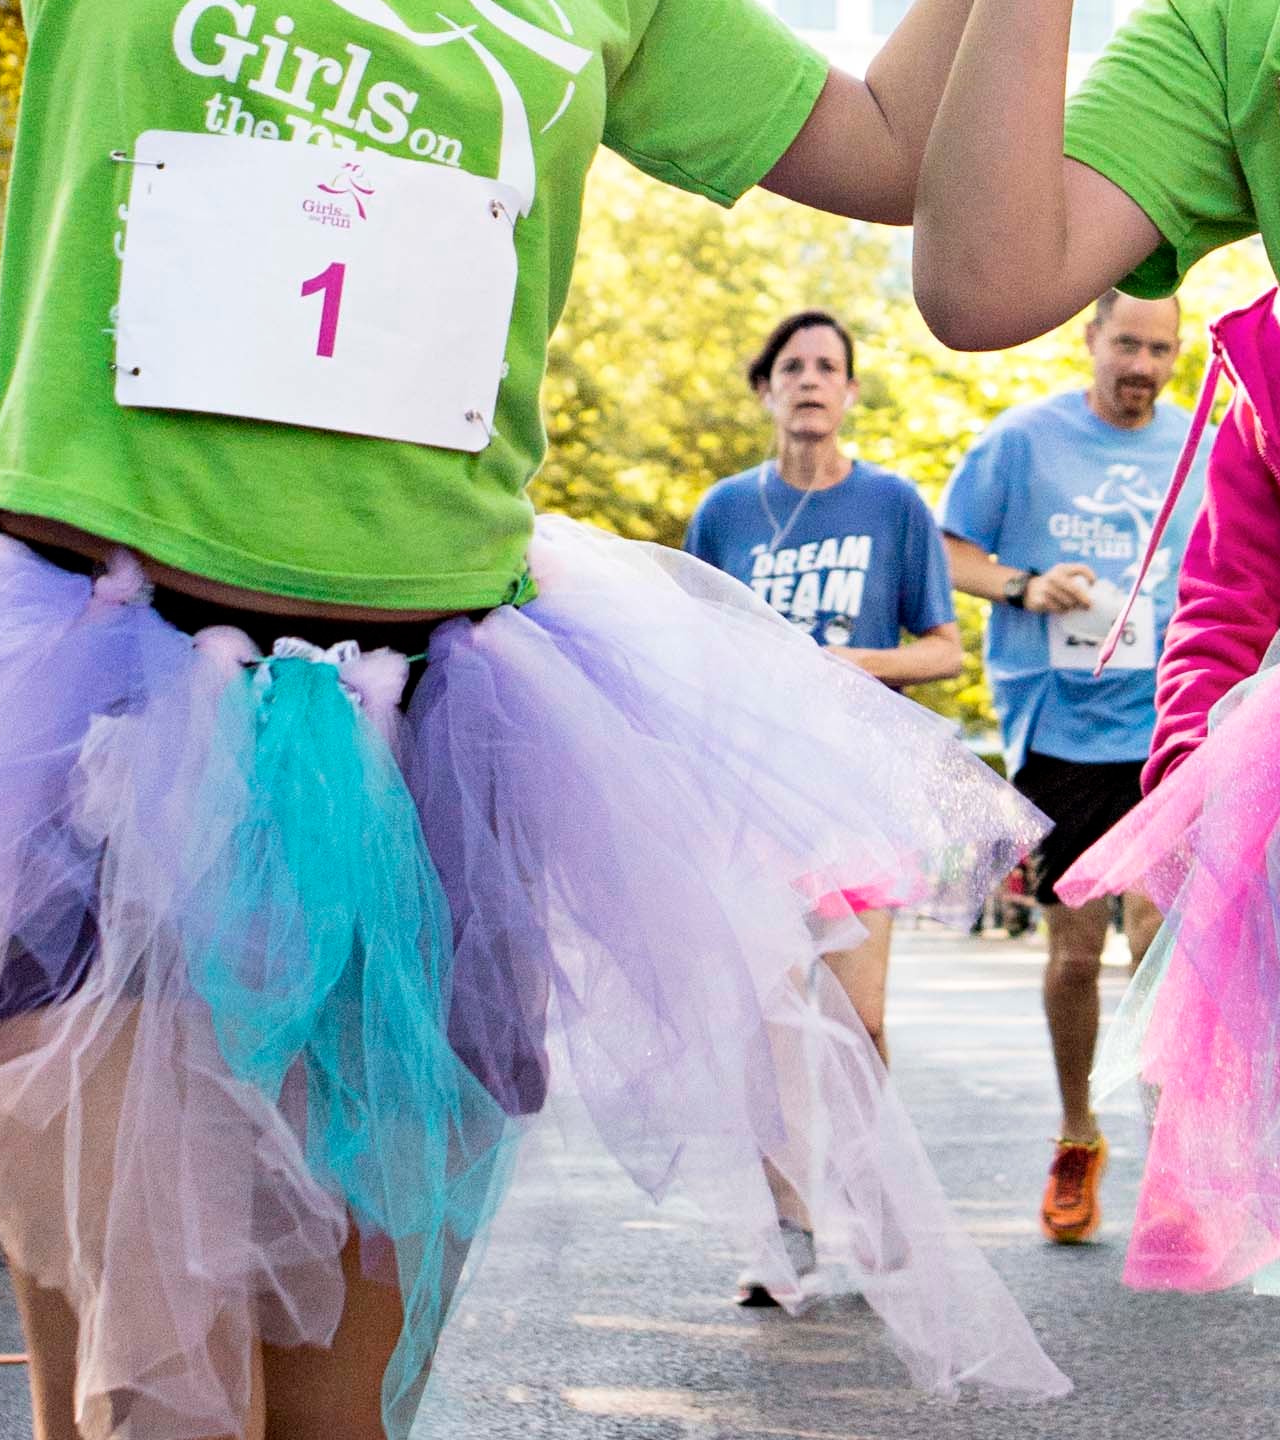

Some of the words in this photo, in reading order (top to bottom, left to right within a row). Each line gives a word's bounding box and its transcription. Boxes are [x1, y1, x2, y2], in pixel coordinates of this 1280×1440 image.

[409, 127, 464, 168] on
[302, 198, 343, 217] Girls
[299, 261, 347, 359] 1
[752, 535, 873, 578] DREAM
[751, 569, 865, 619] TEAM
